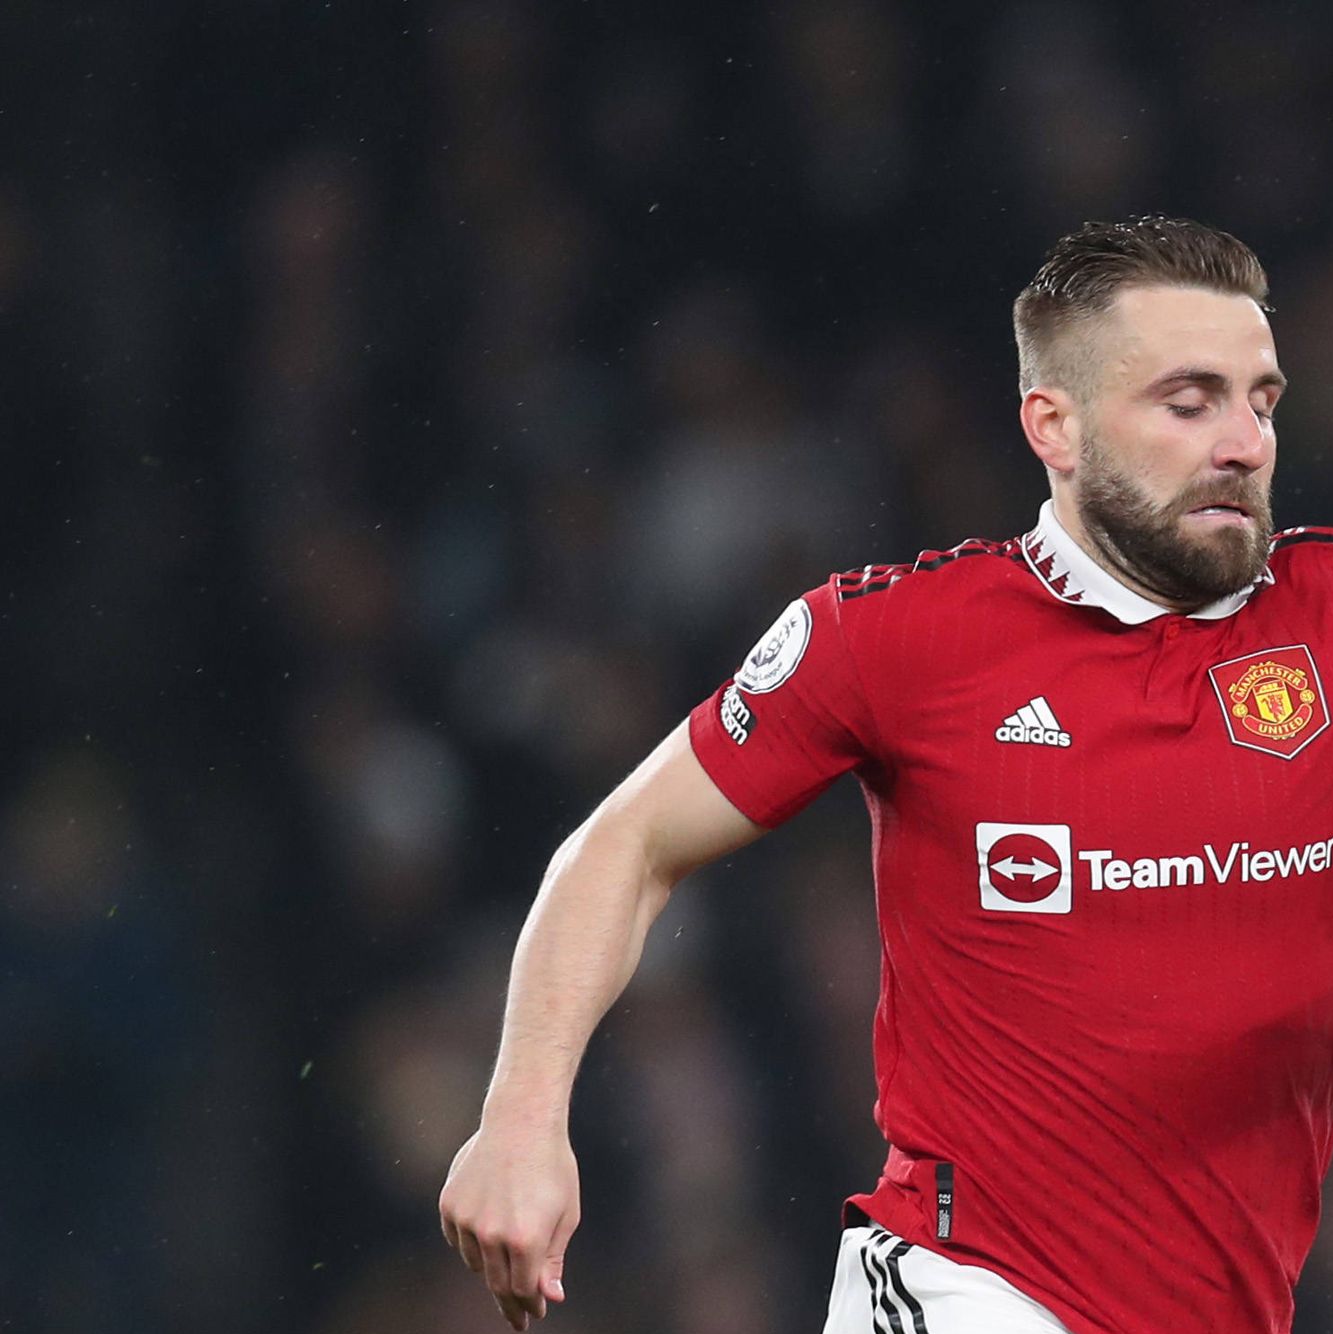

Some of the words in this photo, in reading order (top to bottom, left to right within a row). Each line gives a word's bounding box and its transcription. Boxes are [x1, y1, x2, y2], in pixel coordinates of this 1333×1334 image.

[1236, 666, 1302, 698] MANCHESTER
[994, 725, 1071, 748] adidas
[1258, 716, 1304, 735] UNITED
